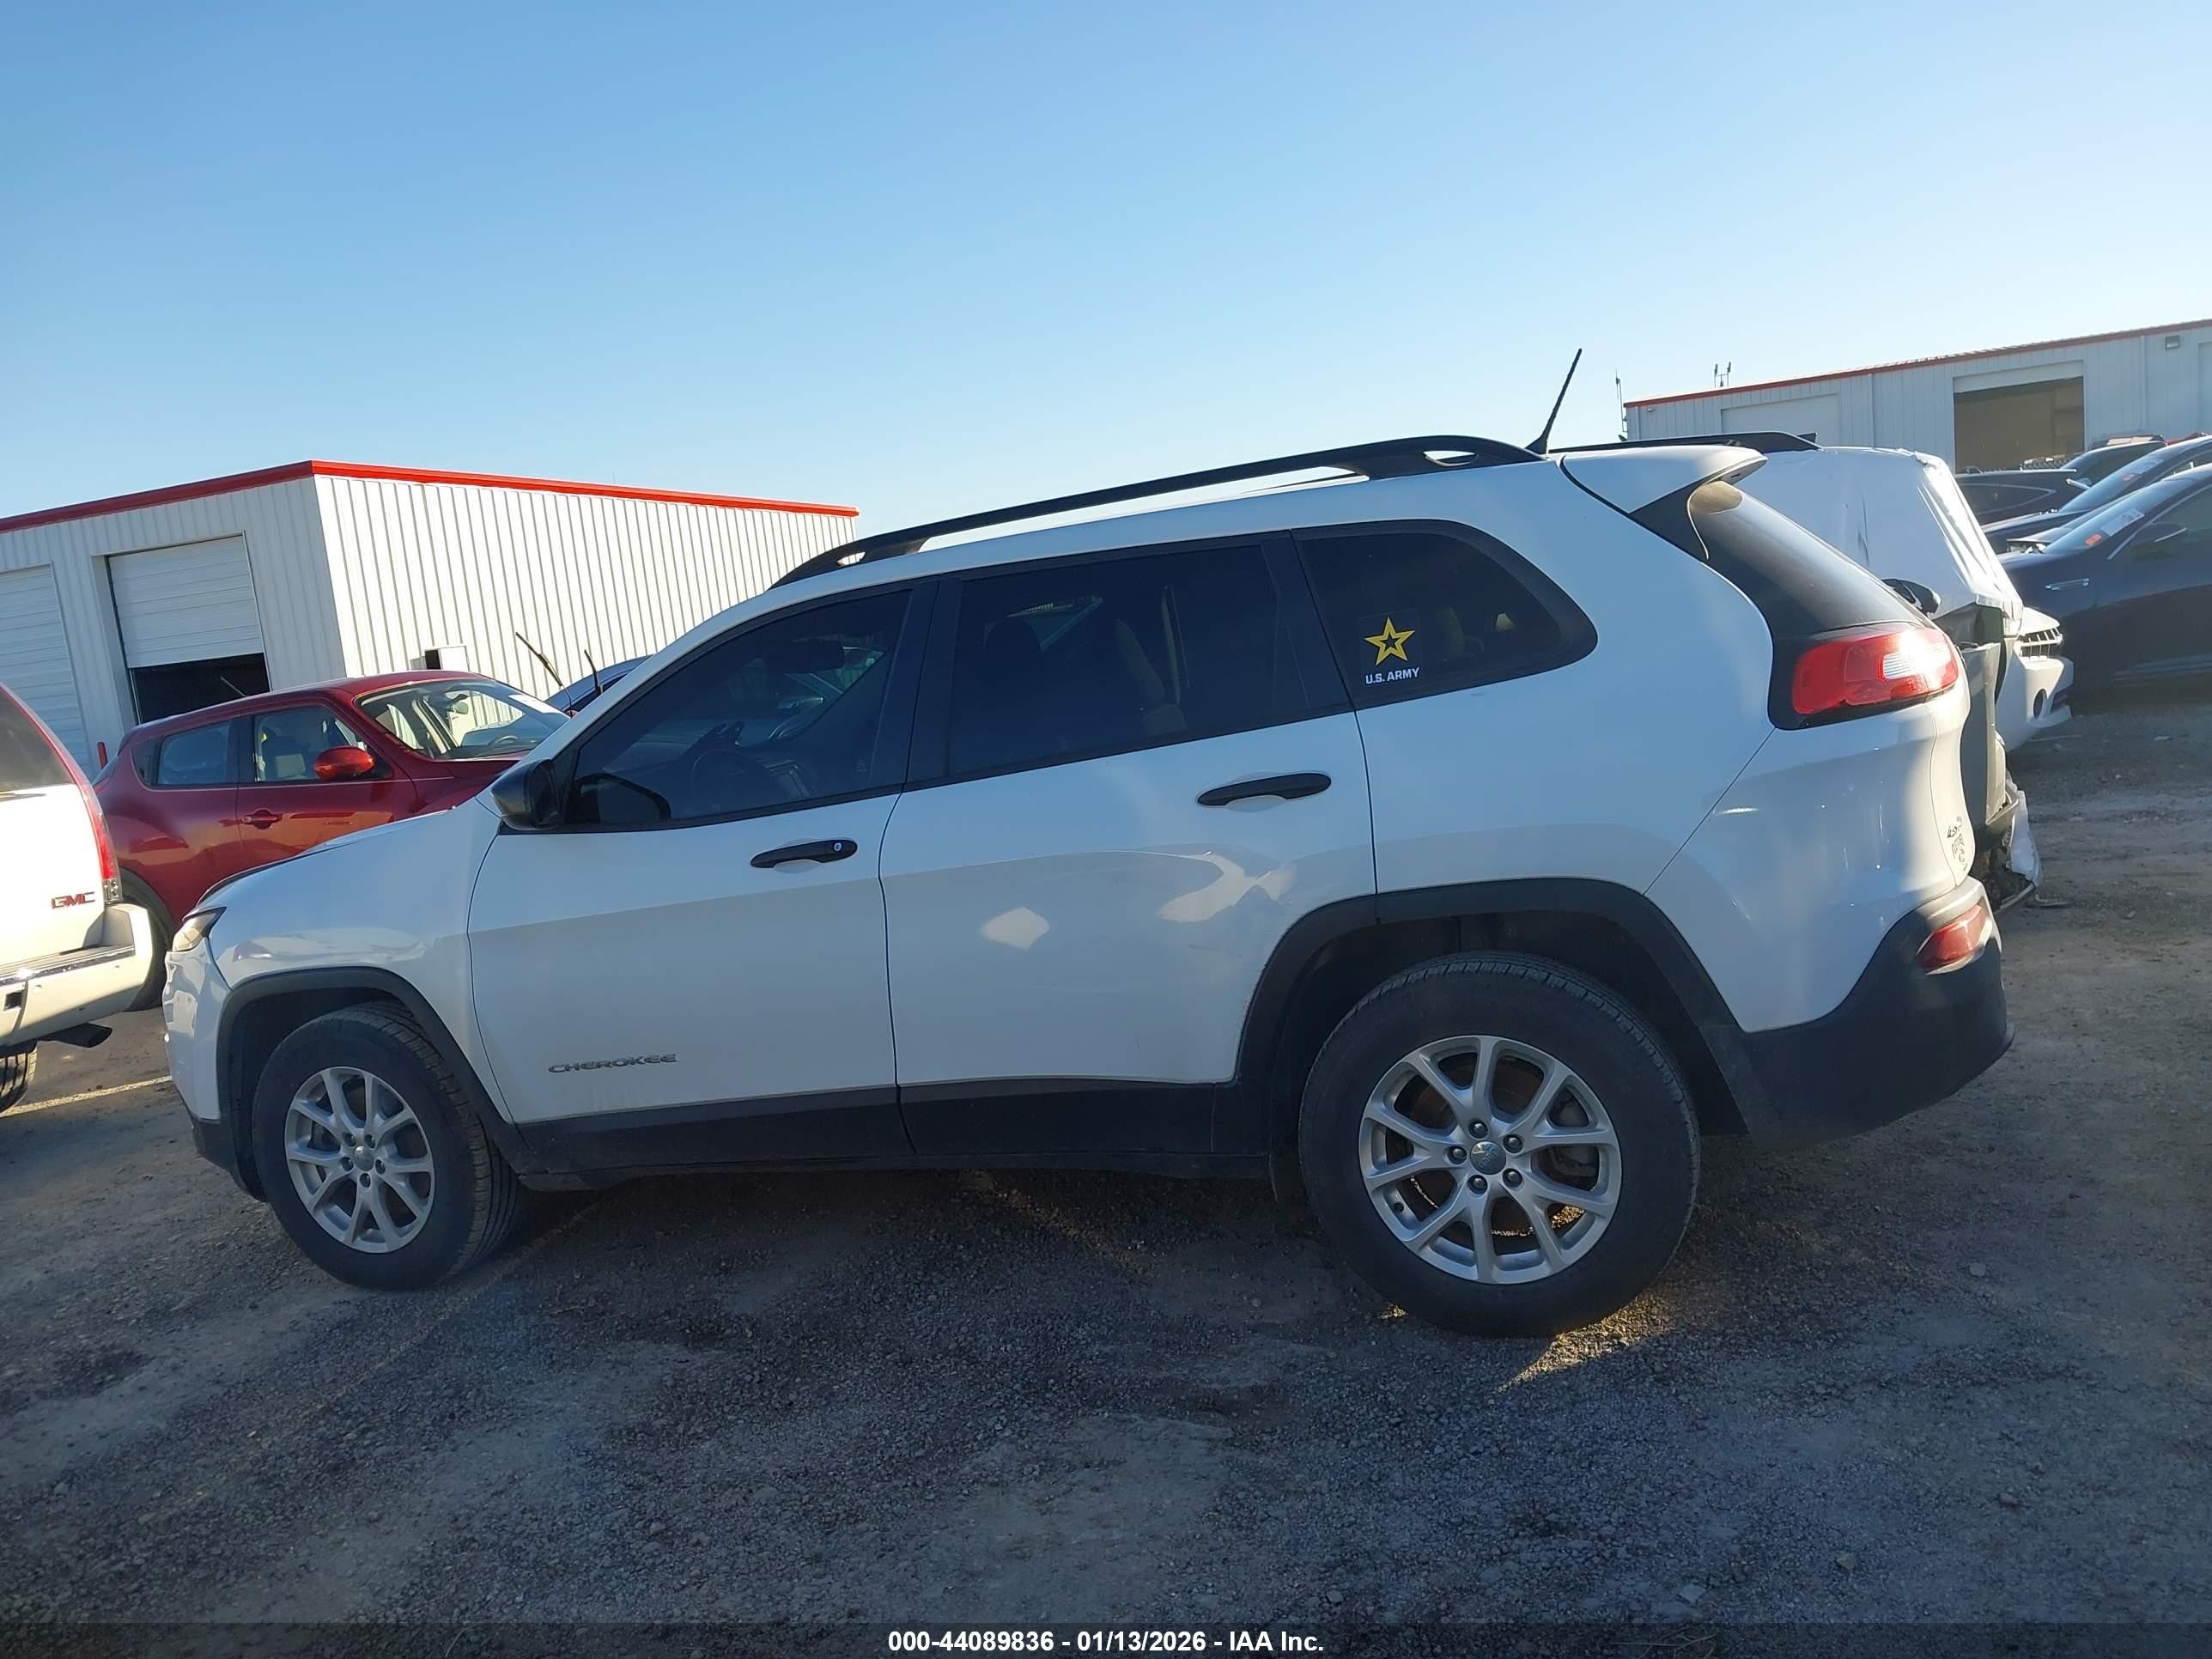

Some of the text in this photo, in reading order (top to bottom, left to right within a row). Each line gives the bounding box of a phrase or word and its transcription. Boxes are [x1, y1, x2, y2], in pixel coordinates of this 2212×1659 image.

[1365, 667, 1419, 684] U.S. ARMY
[52, 891, 95, 908] GMC
[548, 1054, 677, 1073] CHEROKEE
